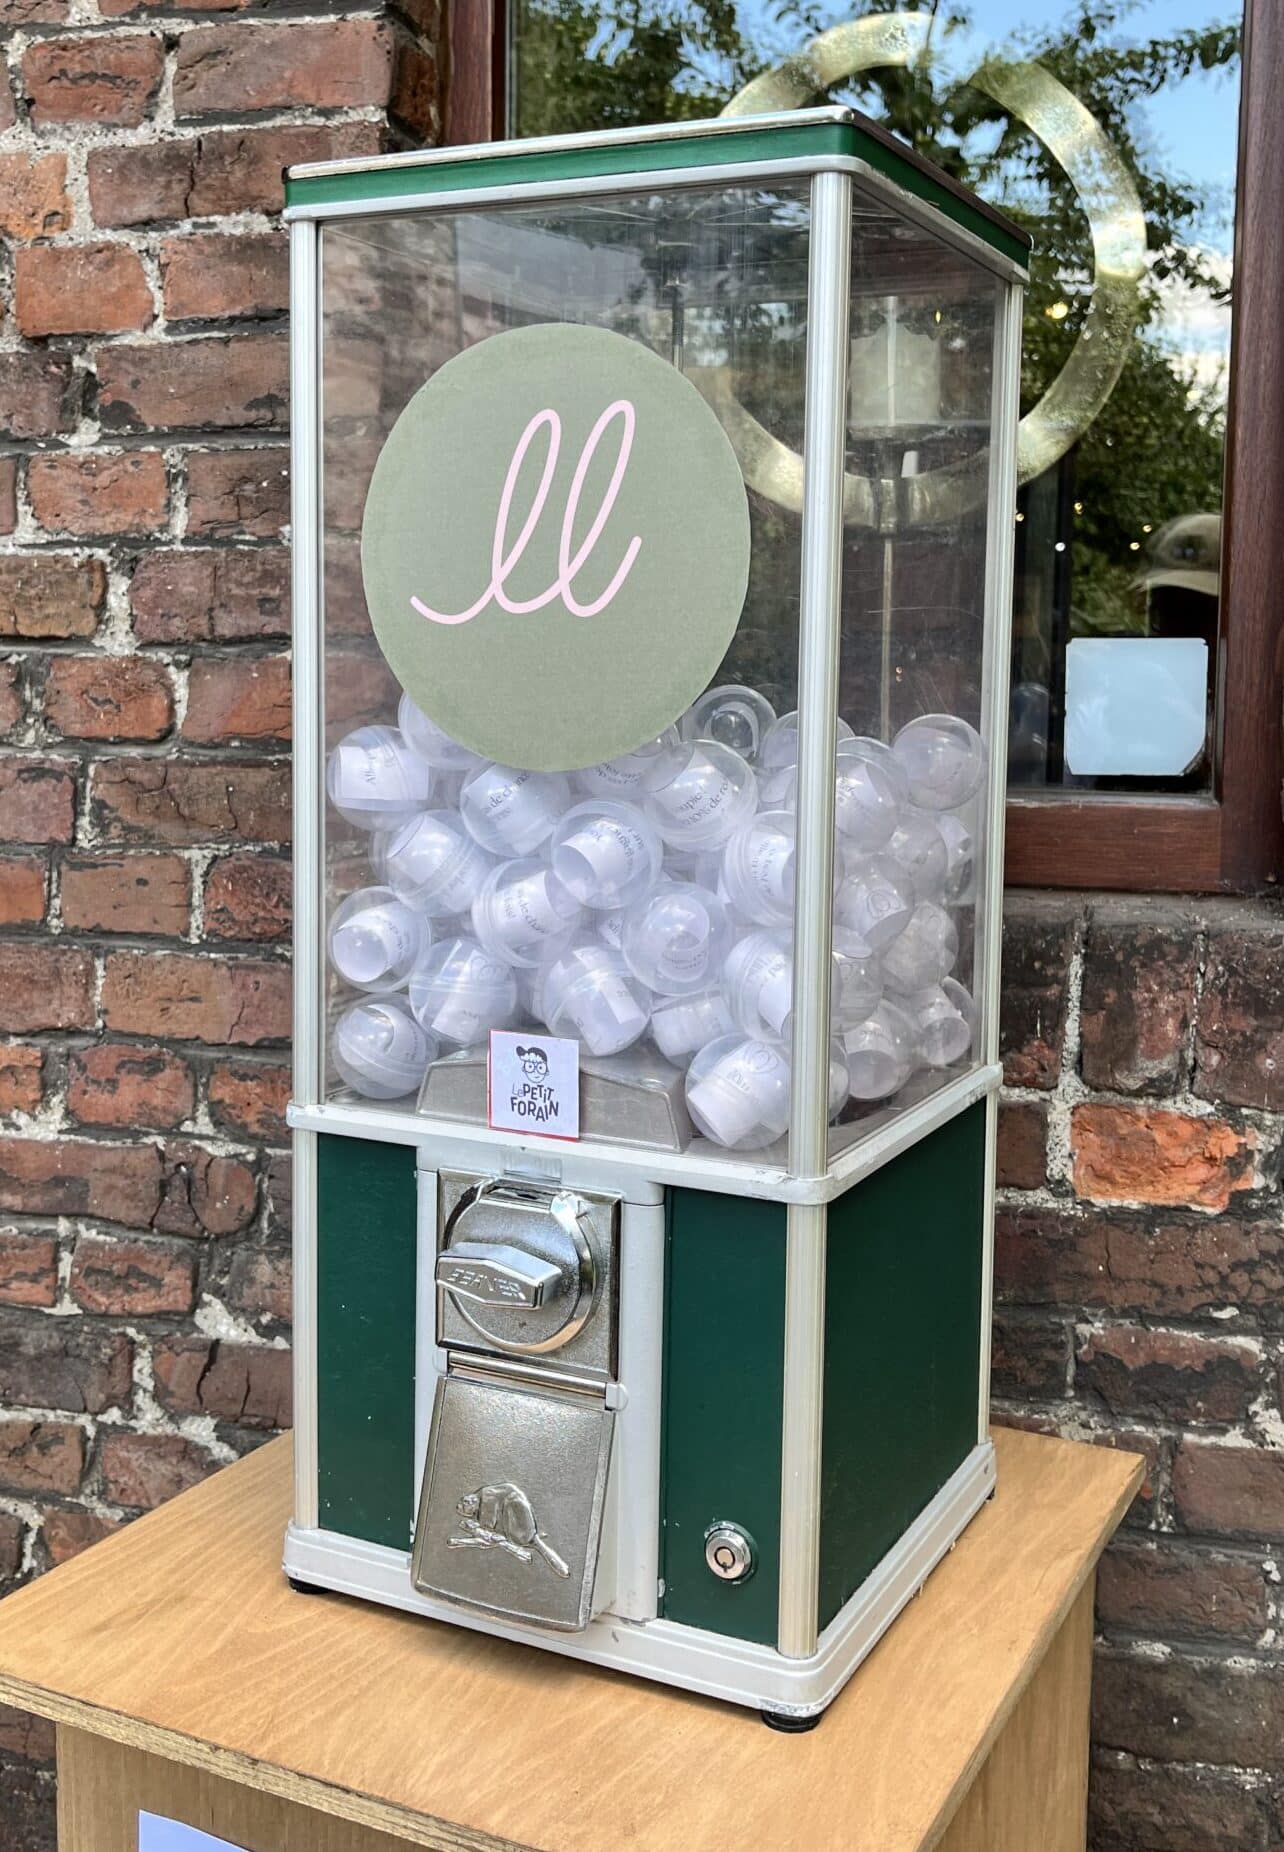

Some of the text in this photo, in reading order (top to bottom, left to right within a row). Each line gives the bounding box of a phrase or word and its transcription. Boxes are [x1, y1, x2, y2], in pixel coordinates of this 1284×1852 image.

[512, 1083, 524, 1097] Le
[510, 1096, 559, 1122] FORAIN
[446, 1268, 526, 1300] BEAVER
